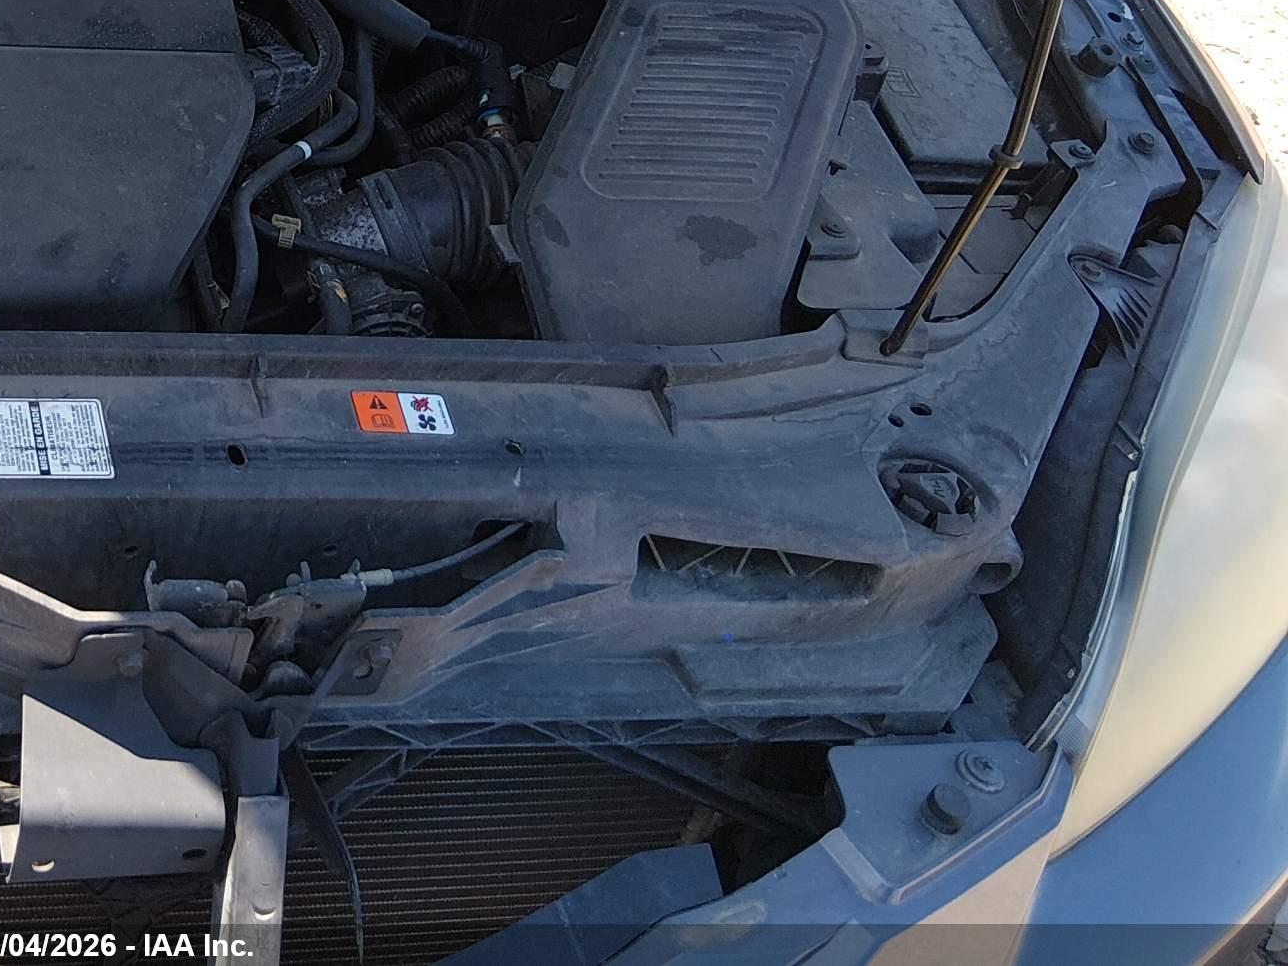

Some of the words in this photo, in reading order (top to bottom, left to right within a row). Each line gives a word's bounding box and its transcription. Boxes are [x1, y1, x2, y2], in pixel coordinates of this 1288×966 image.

[30, 405, 43, 436] GARDE
[35, 436, 45, 449] EN
[37, 449, 49, 471] MISE
